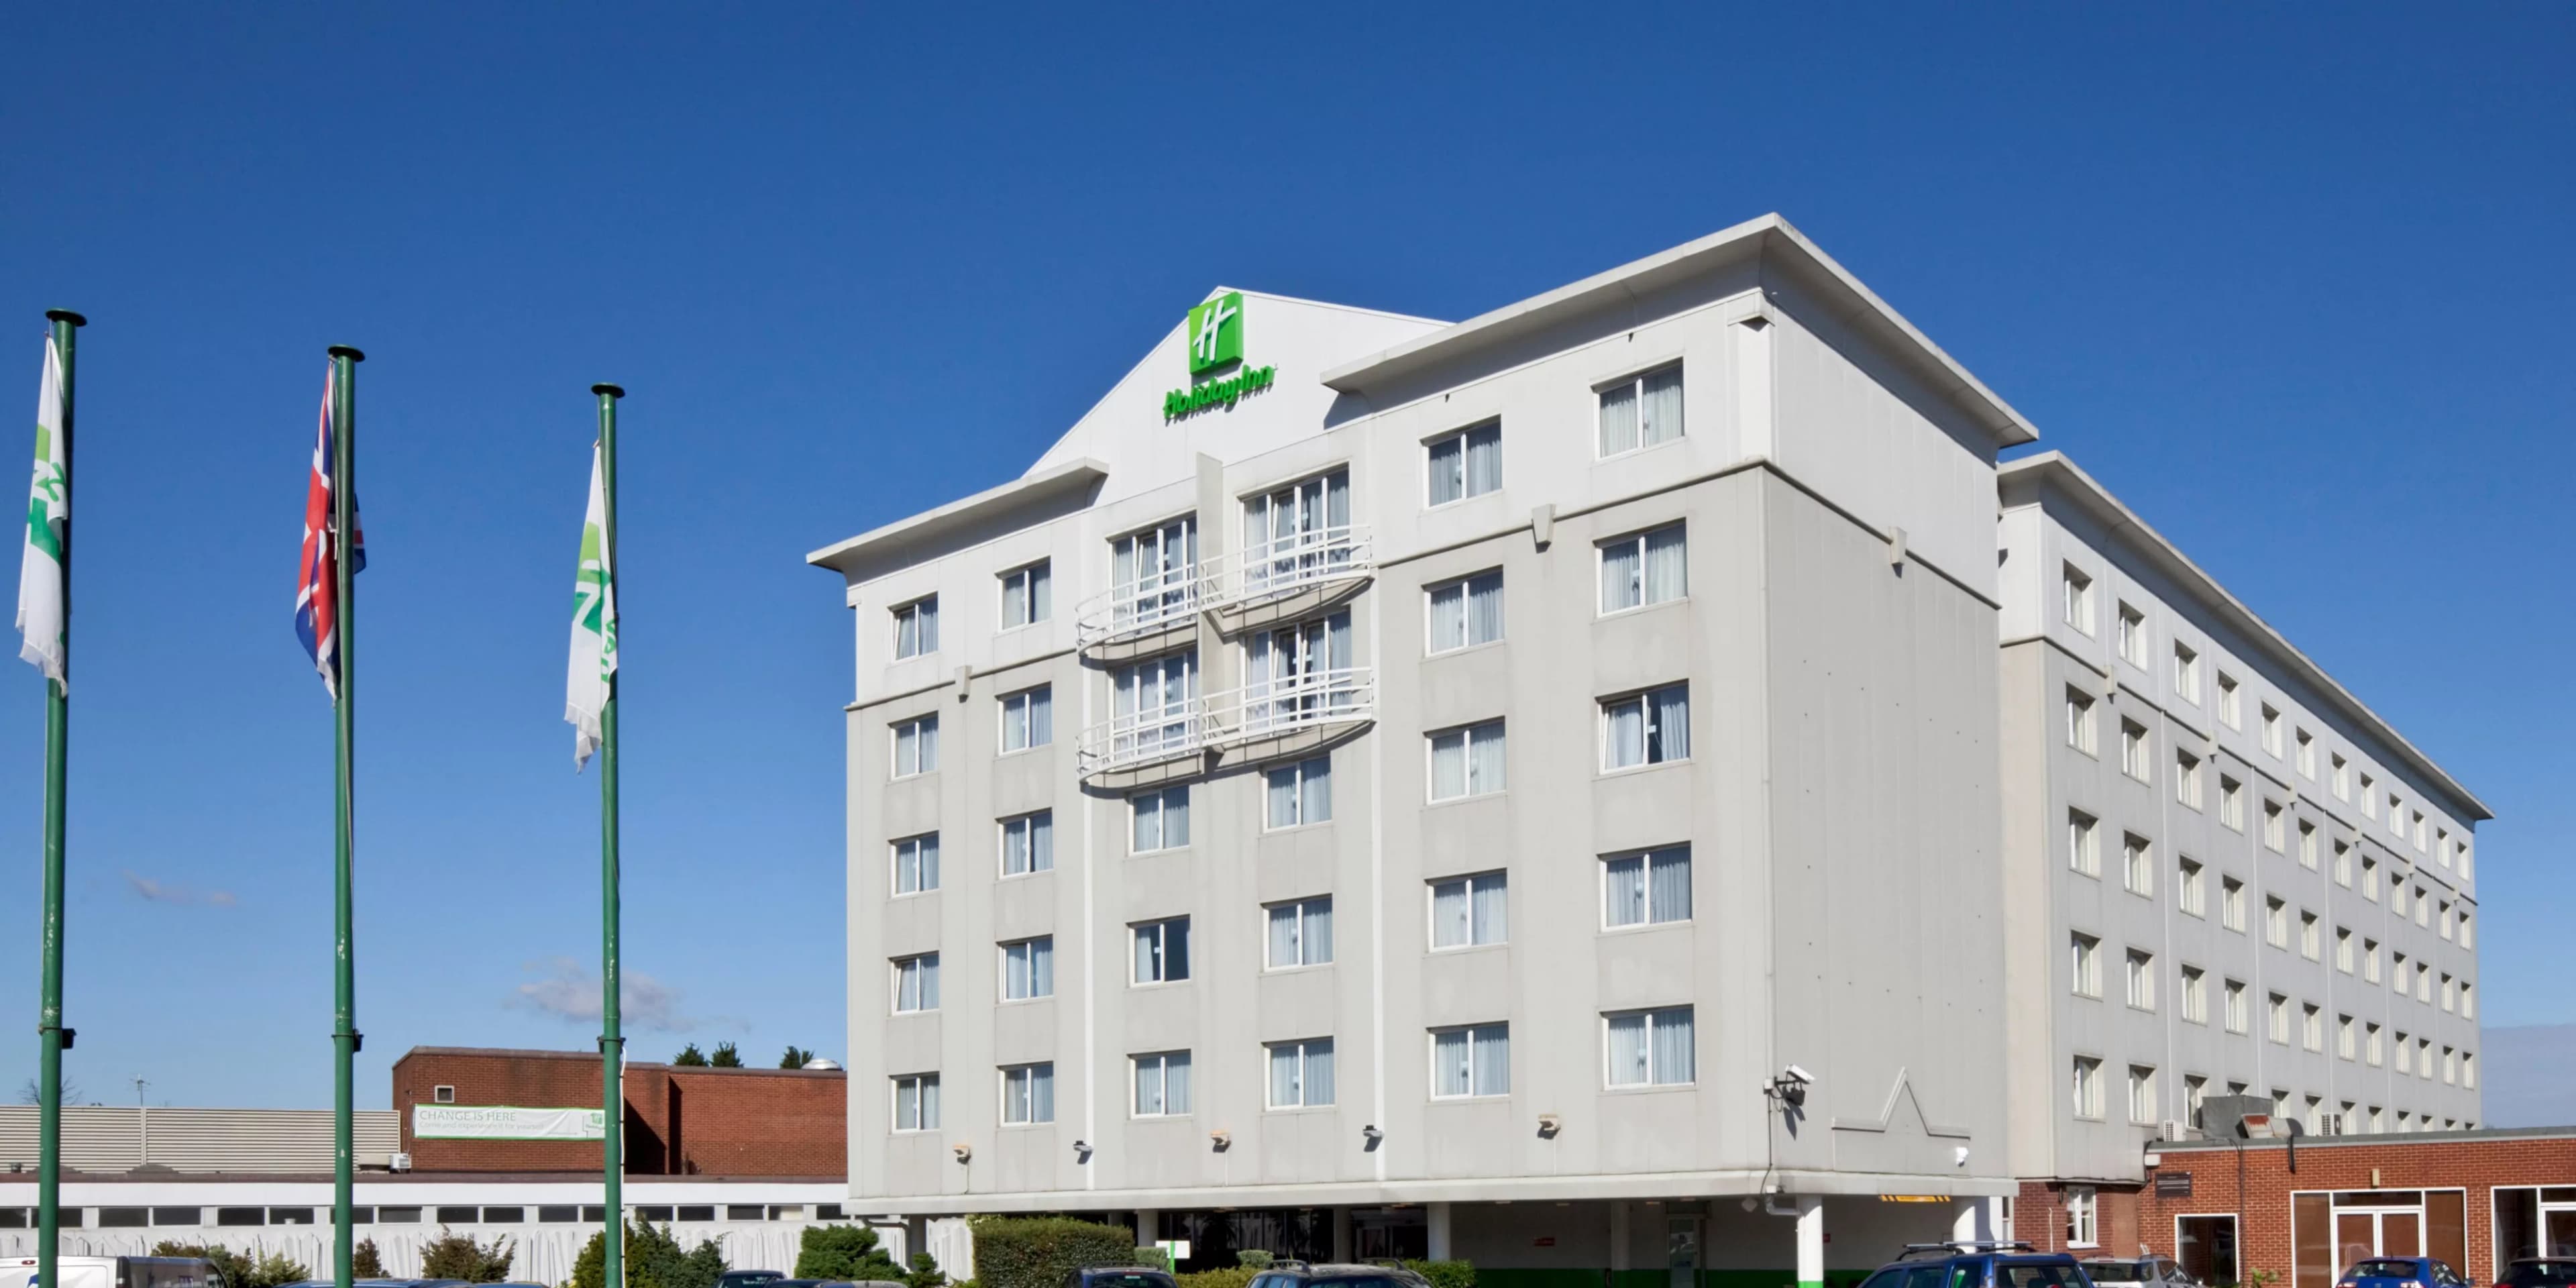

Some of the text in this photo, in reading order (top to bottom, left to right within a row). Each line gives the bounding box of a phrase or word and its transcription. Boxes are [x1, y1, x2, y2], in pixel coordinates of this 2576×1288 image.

[1164, 364, 1275, 419] Holiday Inn
[419, 1110, 516, 1122] CHANGE IS HERE
[442, 1121, 457, 1129] and
